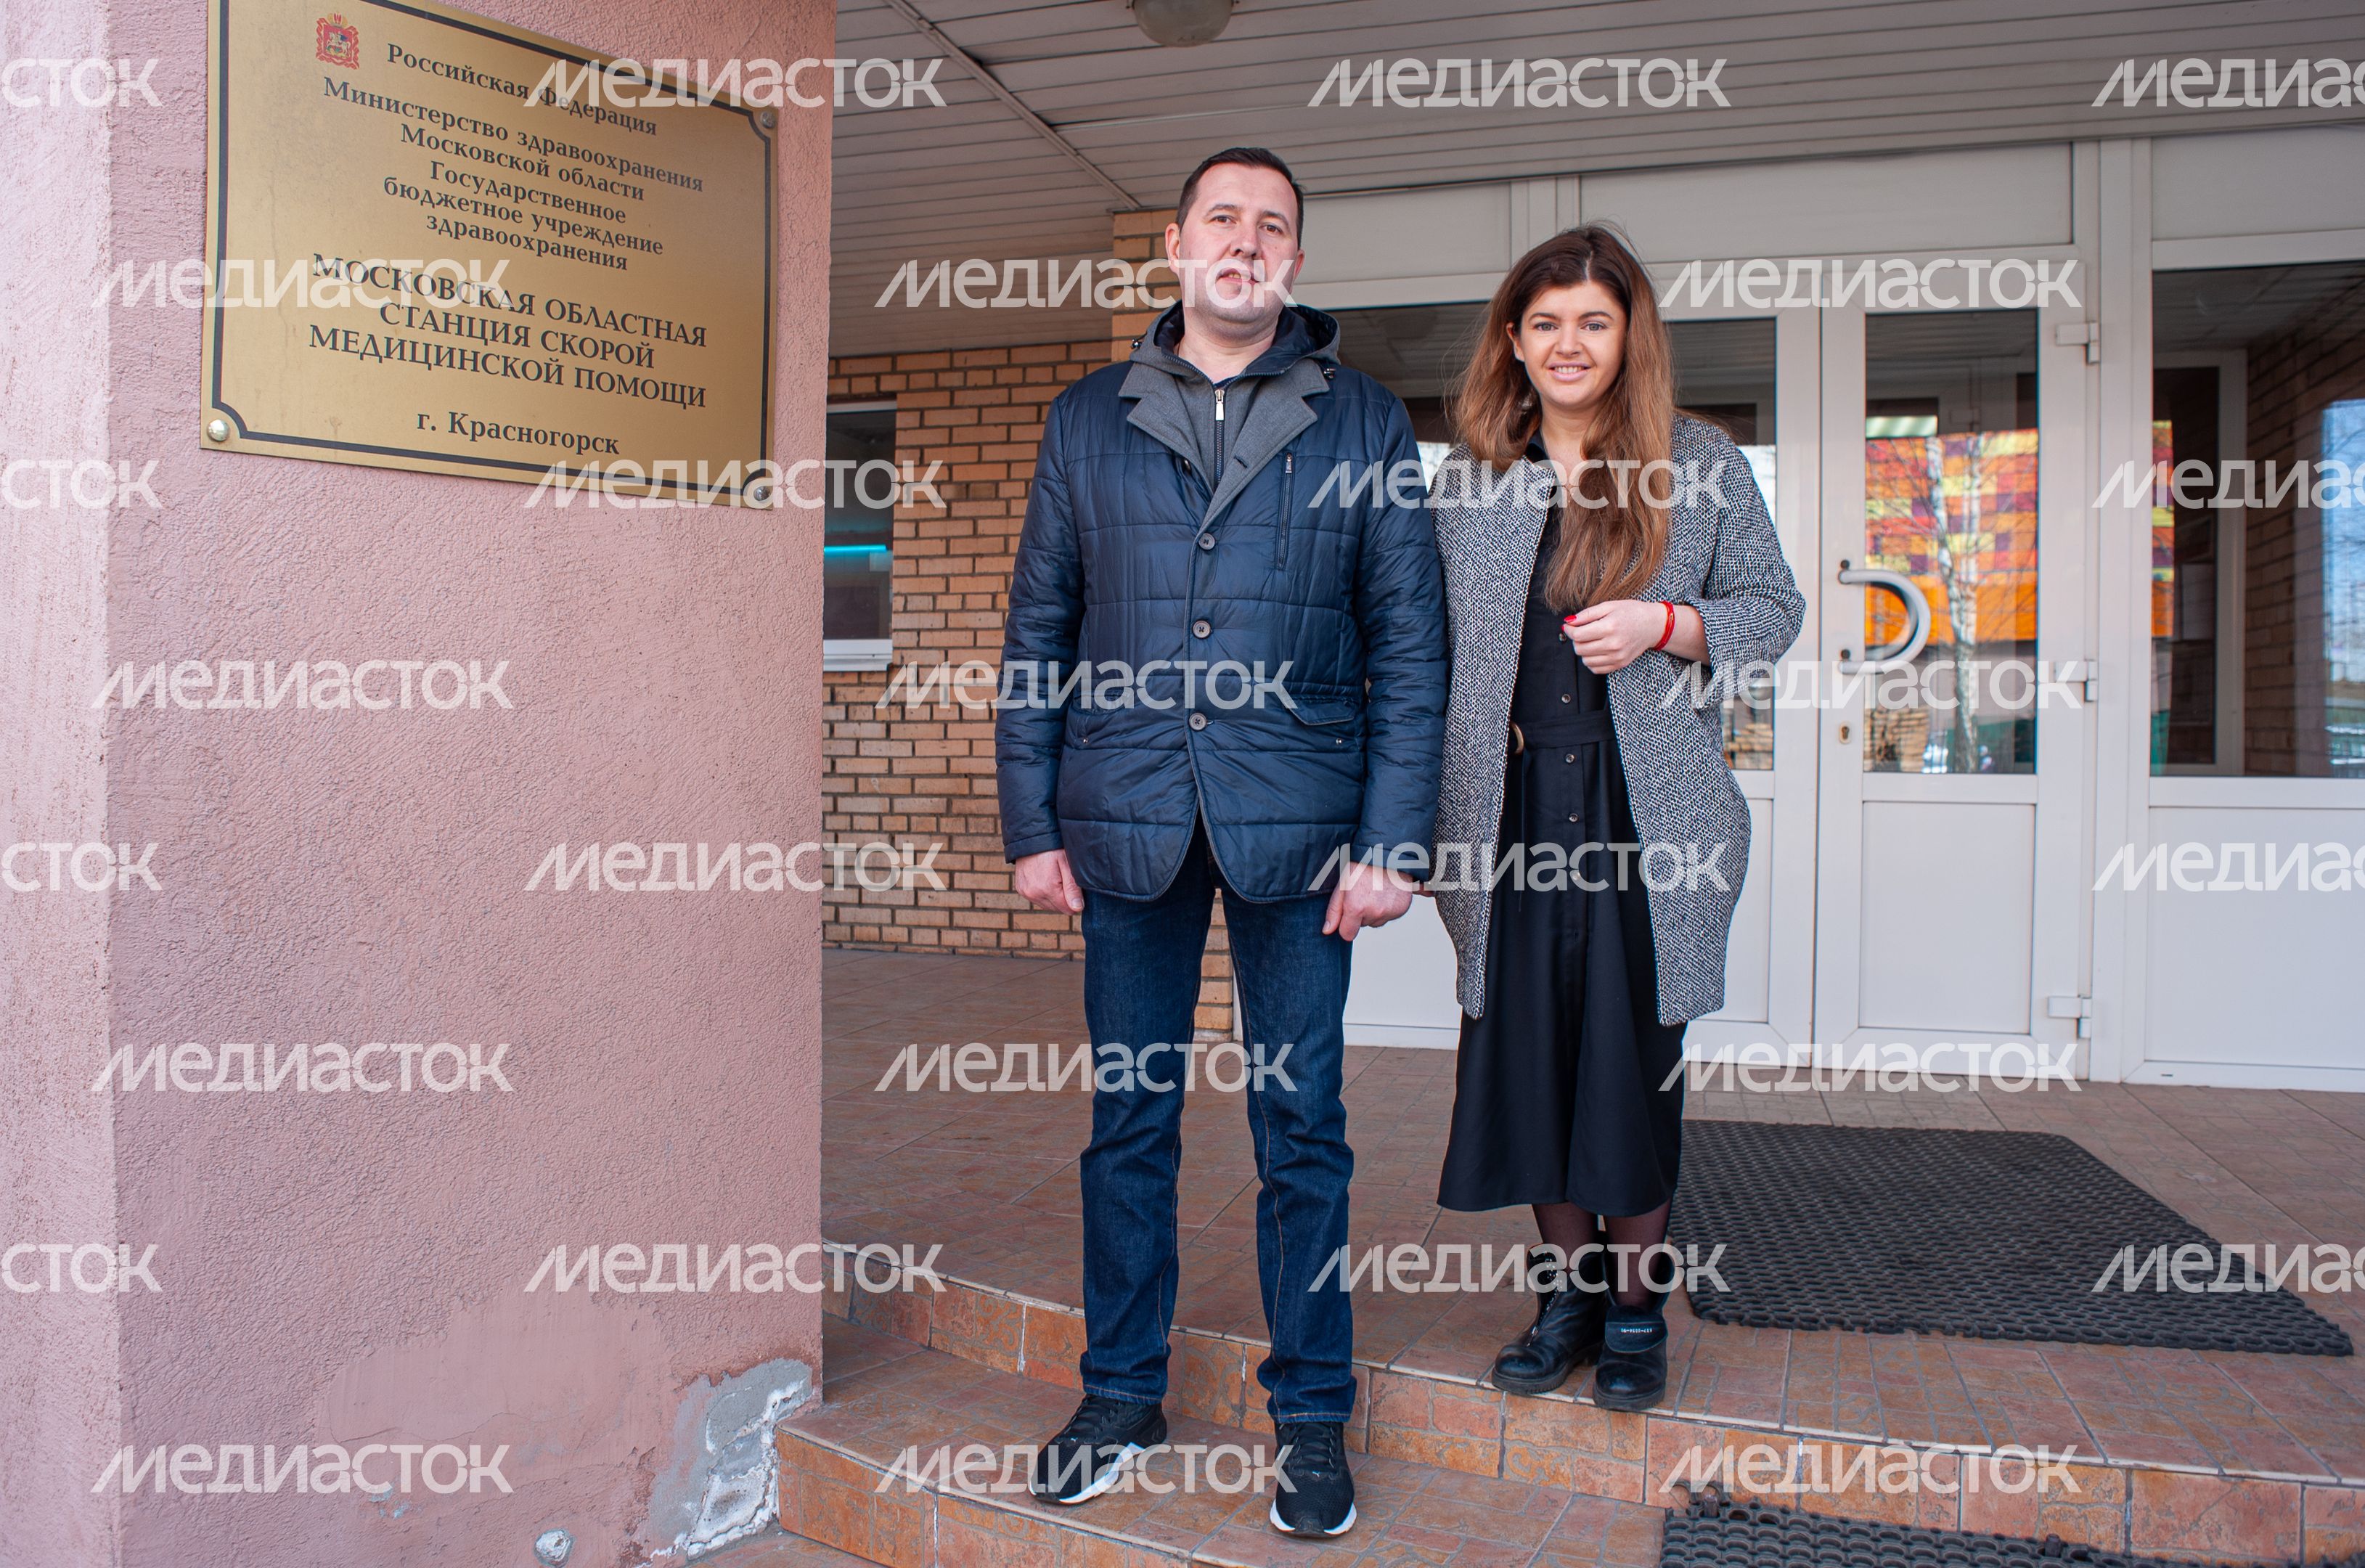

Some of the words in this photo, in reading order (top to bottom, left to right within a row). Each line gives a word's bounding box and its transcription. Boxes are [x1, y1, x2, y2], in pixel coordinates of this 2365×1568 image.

[388, 44, 529, 99] Российская
[537, 86, 657, 135] Федерация
[324, 76, 508, 141] Министерство
[517, 131, 703, 192] здравоохранения
[401, 123, 550, 177] Московской
[558, 168, 644, 200] области
[384, 177, 523, 224] бюджетное
[531, 213, 663, 254] учреждение
[430, 160, 626, 223] Государственное
[427, 216, 627, 270] здравоохранения
[313, 253, 535, 316] МОСКОВСКАЯ
[545, 298, 707, 347] ОБЛАСТНАЯ
[380, 302, 531, 347] СТАНЦИЯ
[541, 330, 655, 368] СКОРОЙ
[309, 324, 564, 385] МЕДИЦИНСКОЙ
[574, 367, 706, 410] ПОМОЩИ
[417, 413, 436, 431] г.
[448, 412, 619, 455] Красногорск
